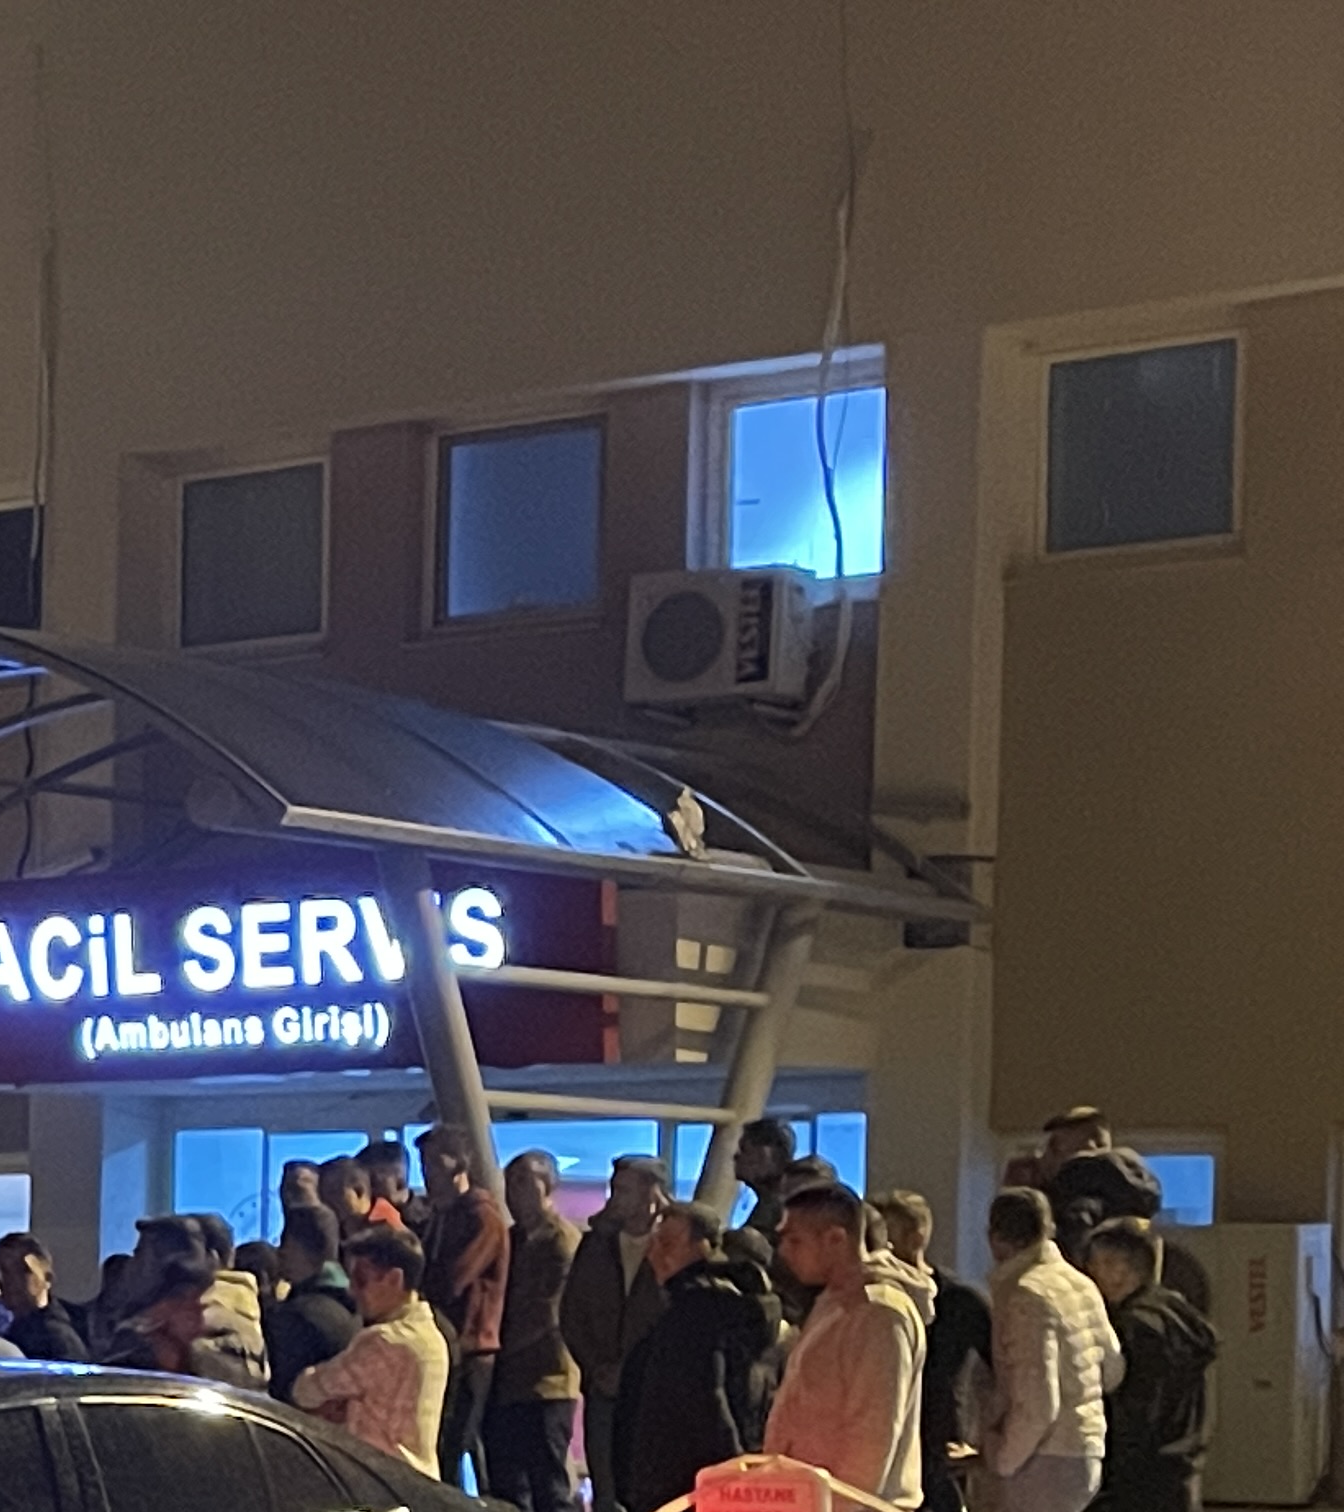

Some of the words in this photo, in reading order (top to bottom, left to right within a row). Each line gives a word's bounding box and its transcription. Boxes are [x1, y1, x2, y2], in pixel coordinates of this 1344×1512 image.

[182, 887, 505, 992] SERVS
[81, 1012, 265, 1061] (Ambulans
[272, 1002, 391, 1049] Girişi)
[719, 1486, 797, 1504] HASTANE
